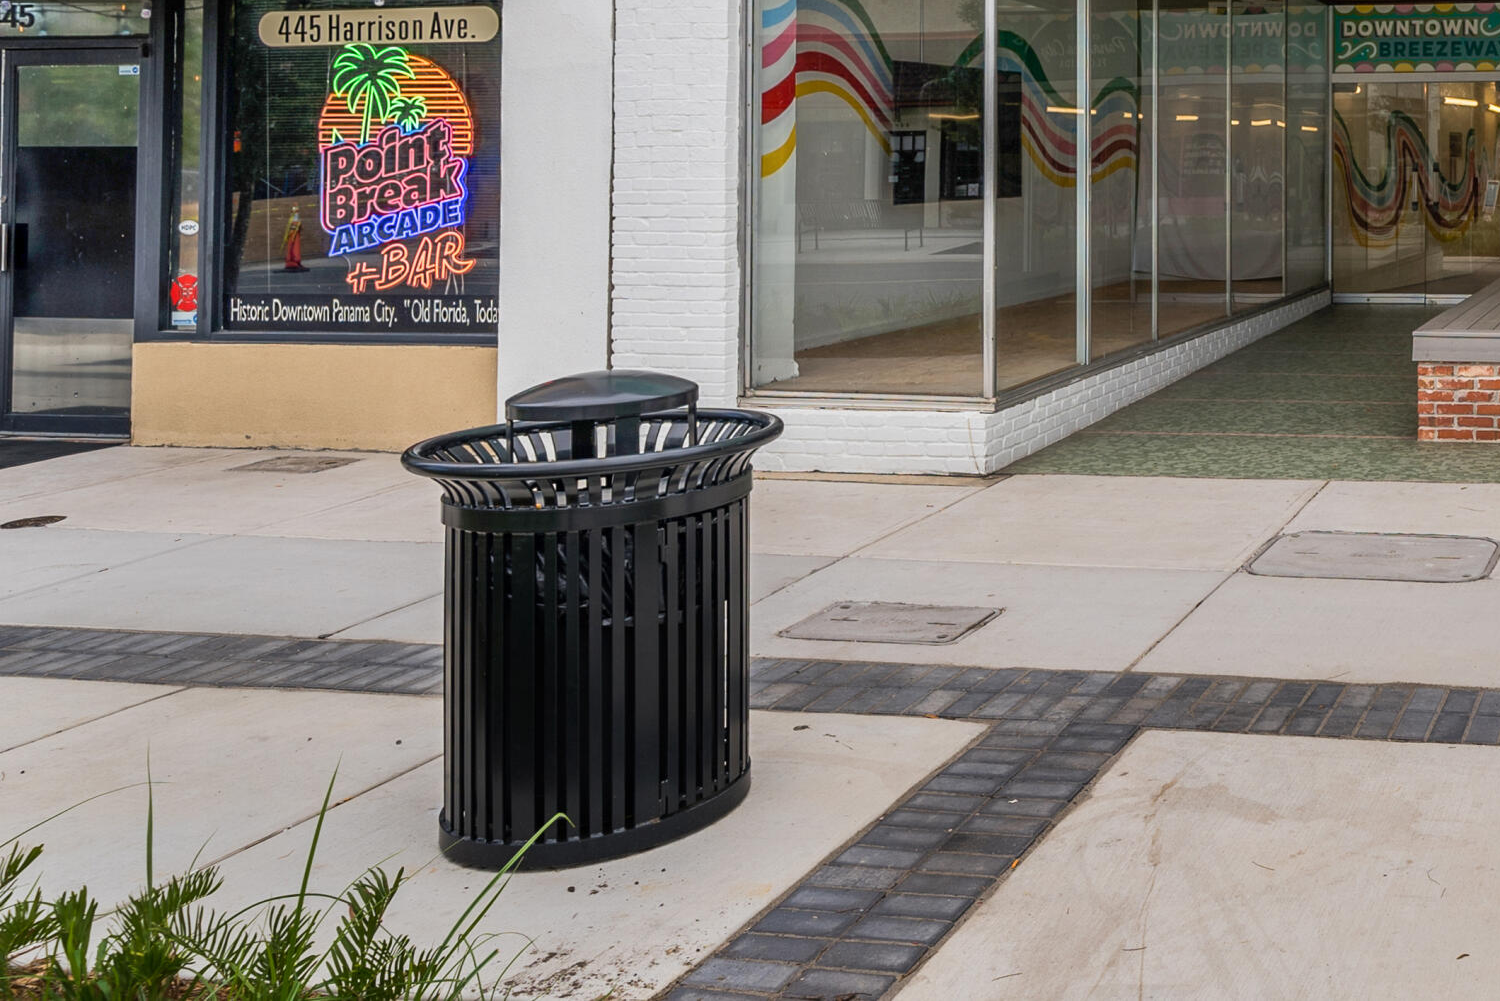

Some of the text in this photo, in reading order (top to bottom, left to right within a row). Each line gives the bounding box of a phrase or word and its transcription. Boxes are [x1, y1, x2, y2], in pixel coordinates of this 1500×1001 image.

[278, 11, 477, 43] 445 Harrison Ave.
[1342, 19, 1479, 37] DOWNTOWN
[327, 121, 451, 190] Point
[327, 161, 462, 229] Break
[329, 198, 463, 257] ARCADE
[230, 298, 270, 323] Historic
[272, 298, 330, 323] Downtown
[332, 298, 371, 323] Panama
[374, 298, 398, 328] City.
[403, 298, 430, 324] "Old
[433, 299, 470, 326] Florida,
